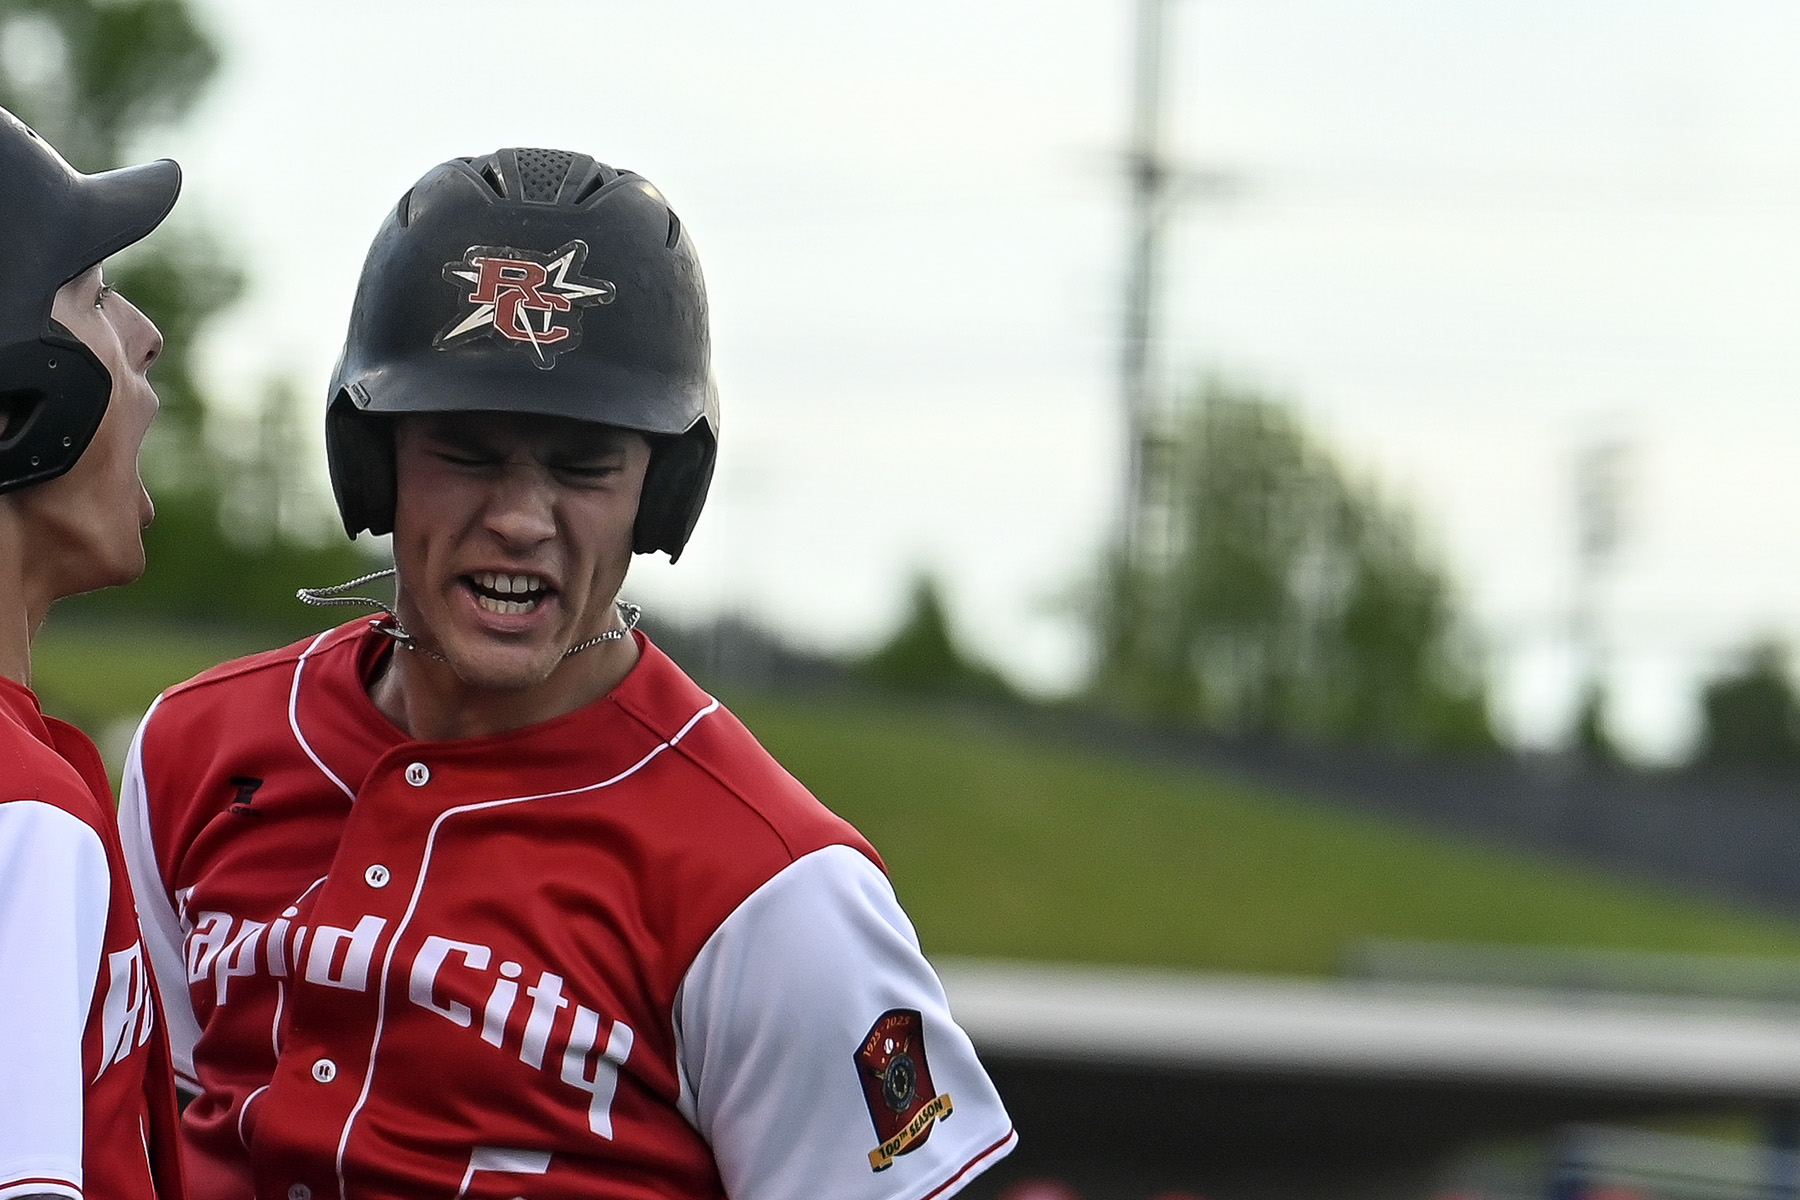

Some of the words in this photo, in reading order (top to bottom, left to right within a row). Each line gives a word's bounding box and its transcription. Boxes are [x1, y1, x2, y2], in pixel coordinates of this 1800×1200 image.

[468, 256, 572, 345] RC
[408, 935, 635, 1141] City
[909, 1098, 944, 1137] SEASON
